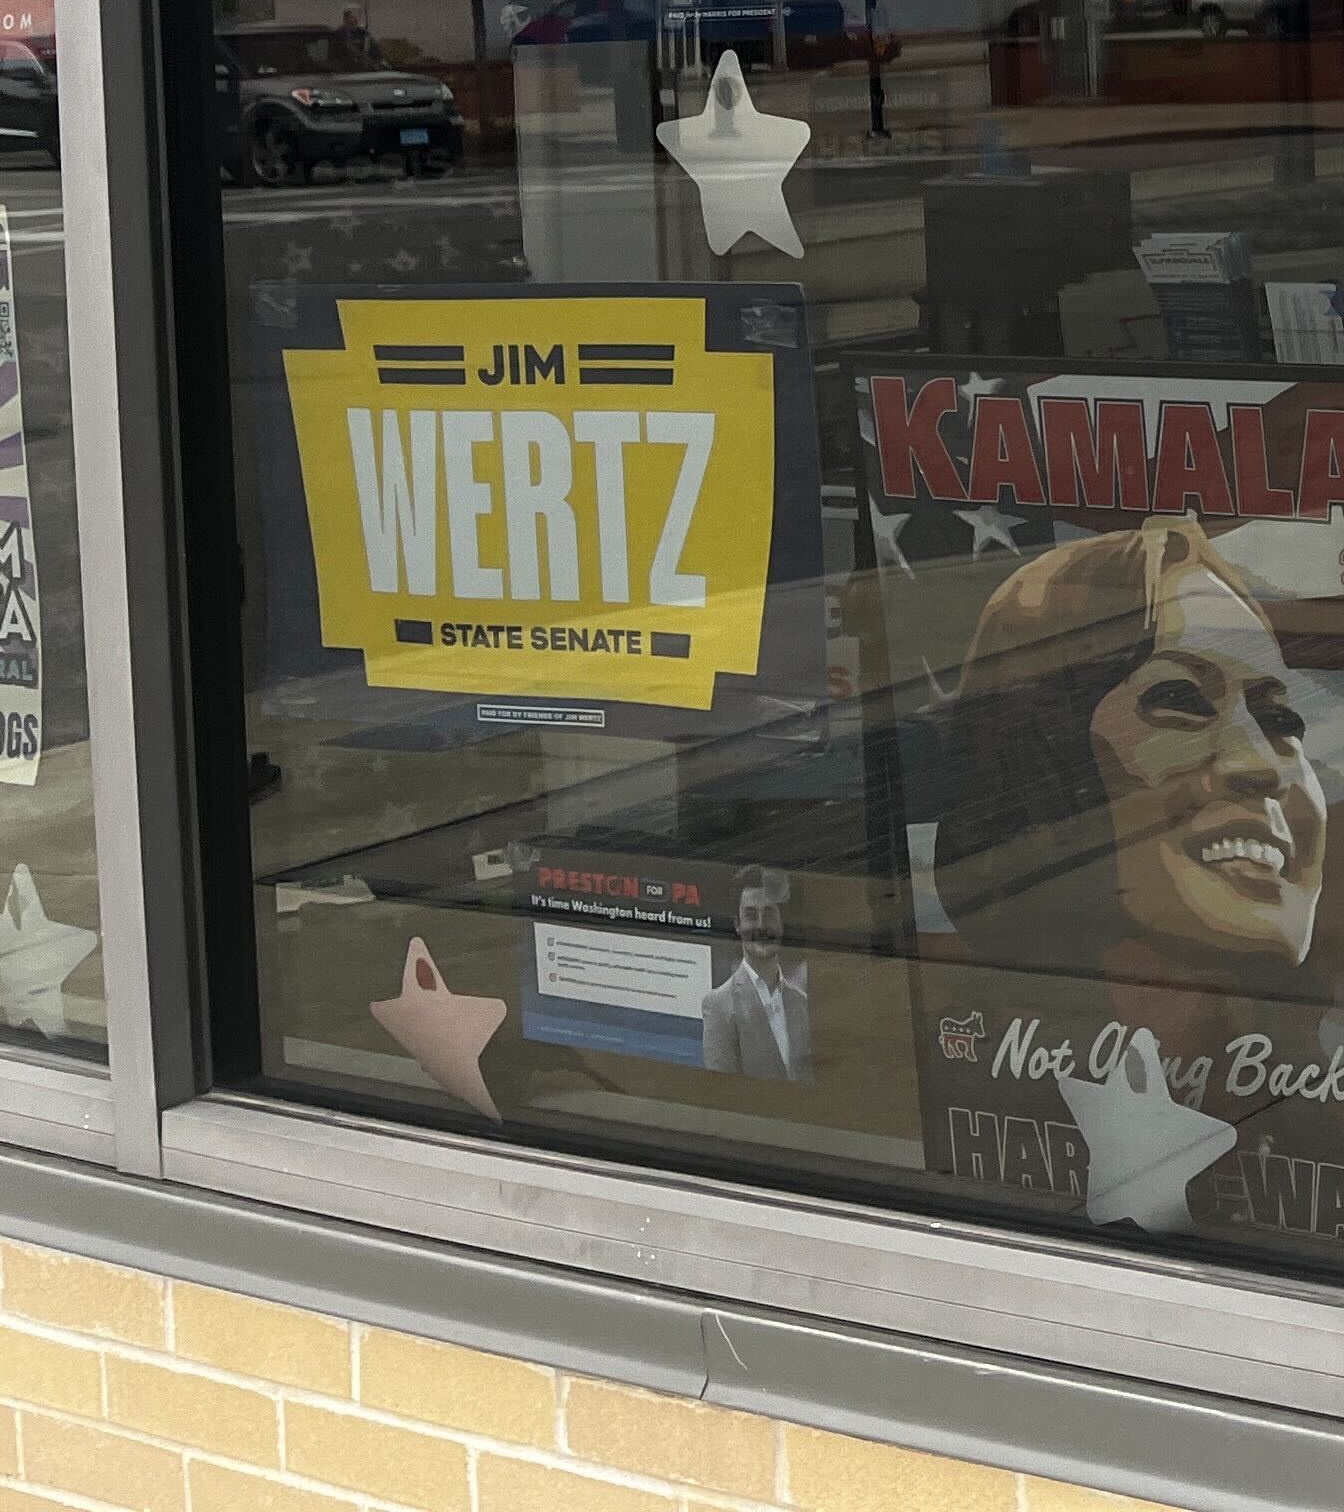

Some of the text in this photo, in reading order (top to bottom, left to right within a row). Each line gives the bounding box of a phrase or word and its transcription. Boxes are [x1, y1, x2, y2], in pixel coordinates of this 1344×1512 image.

[478, 344, 565, 386] JIM
[346, 408, 716, 607] WERTZ
[441, 622, 642, 655] STATE SENATE
[538, 867, 700, 906] PRESTON FOR PA
[531, 894, 712, 929] It's time Washington heard from us!
[991, 1017, 1076, 1081] Not
